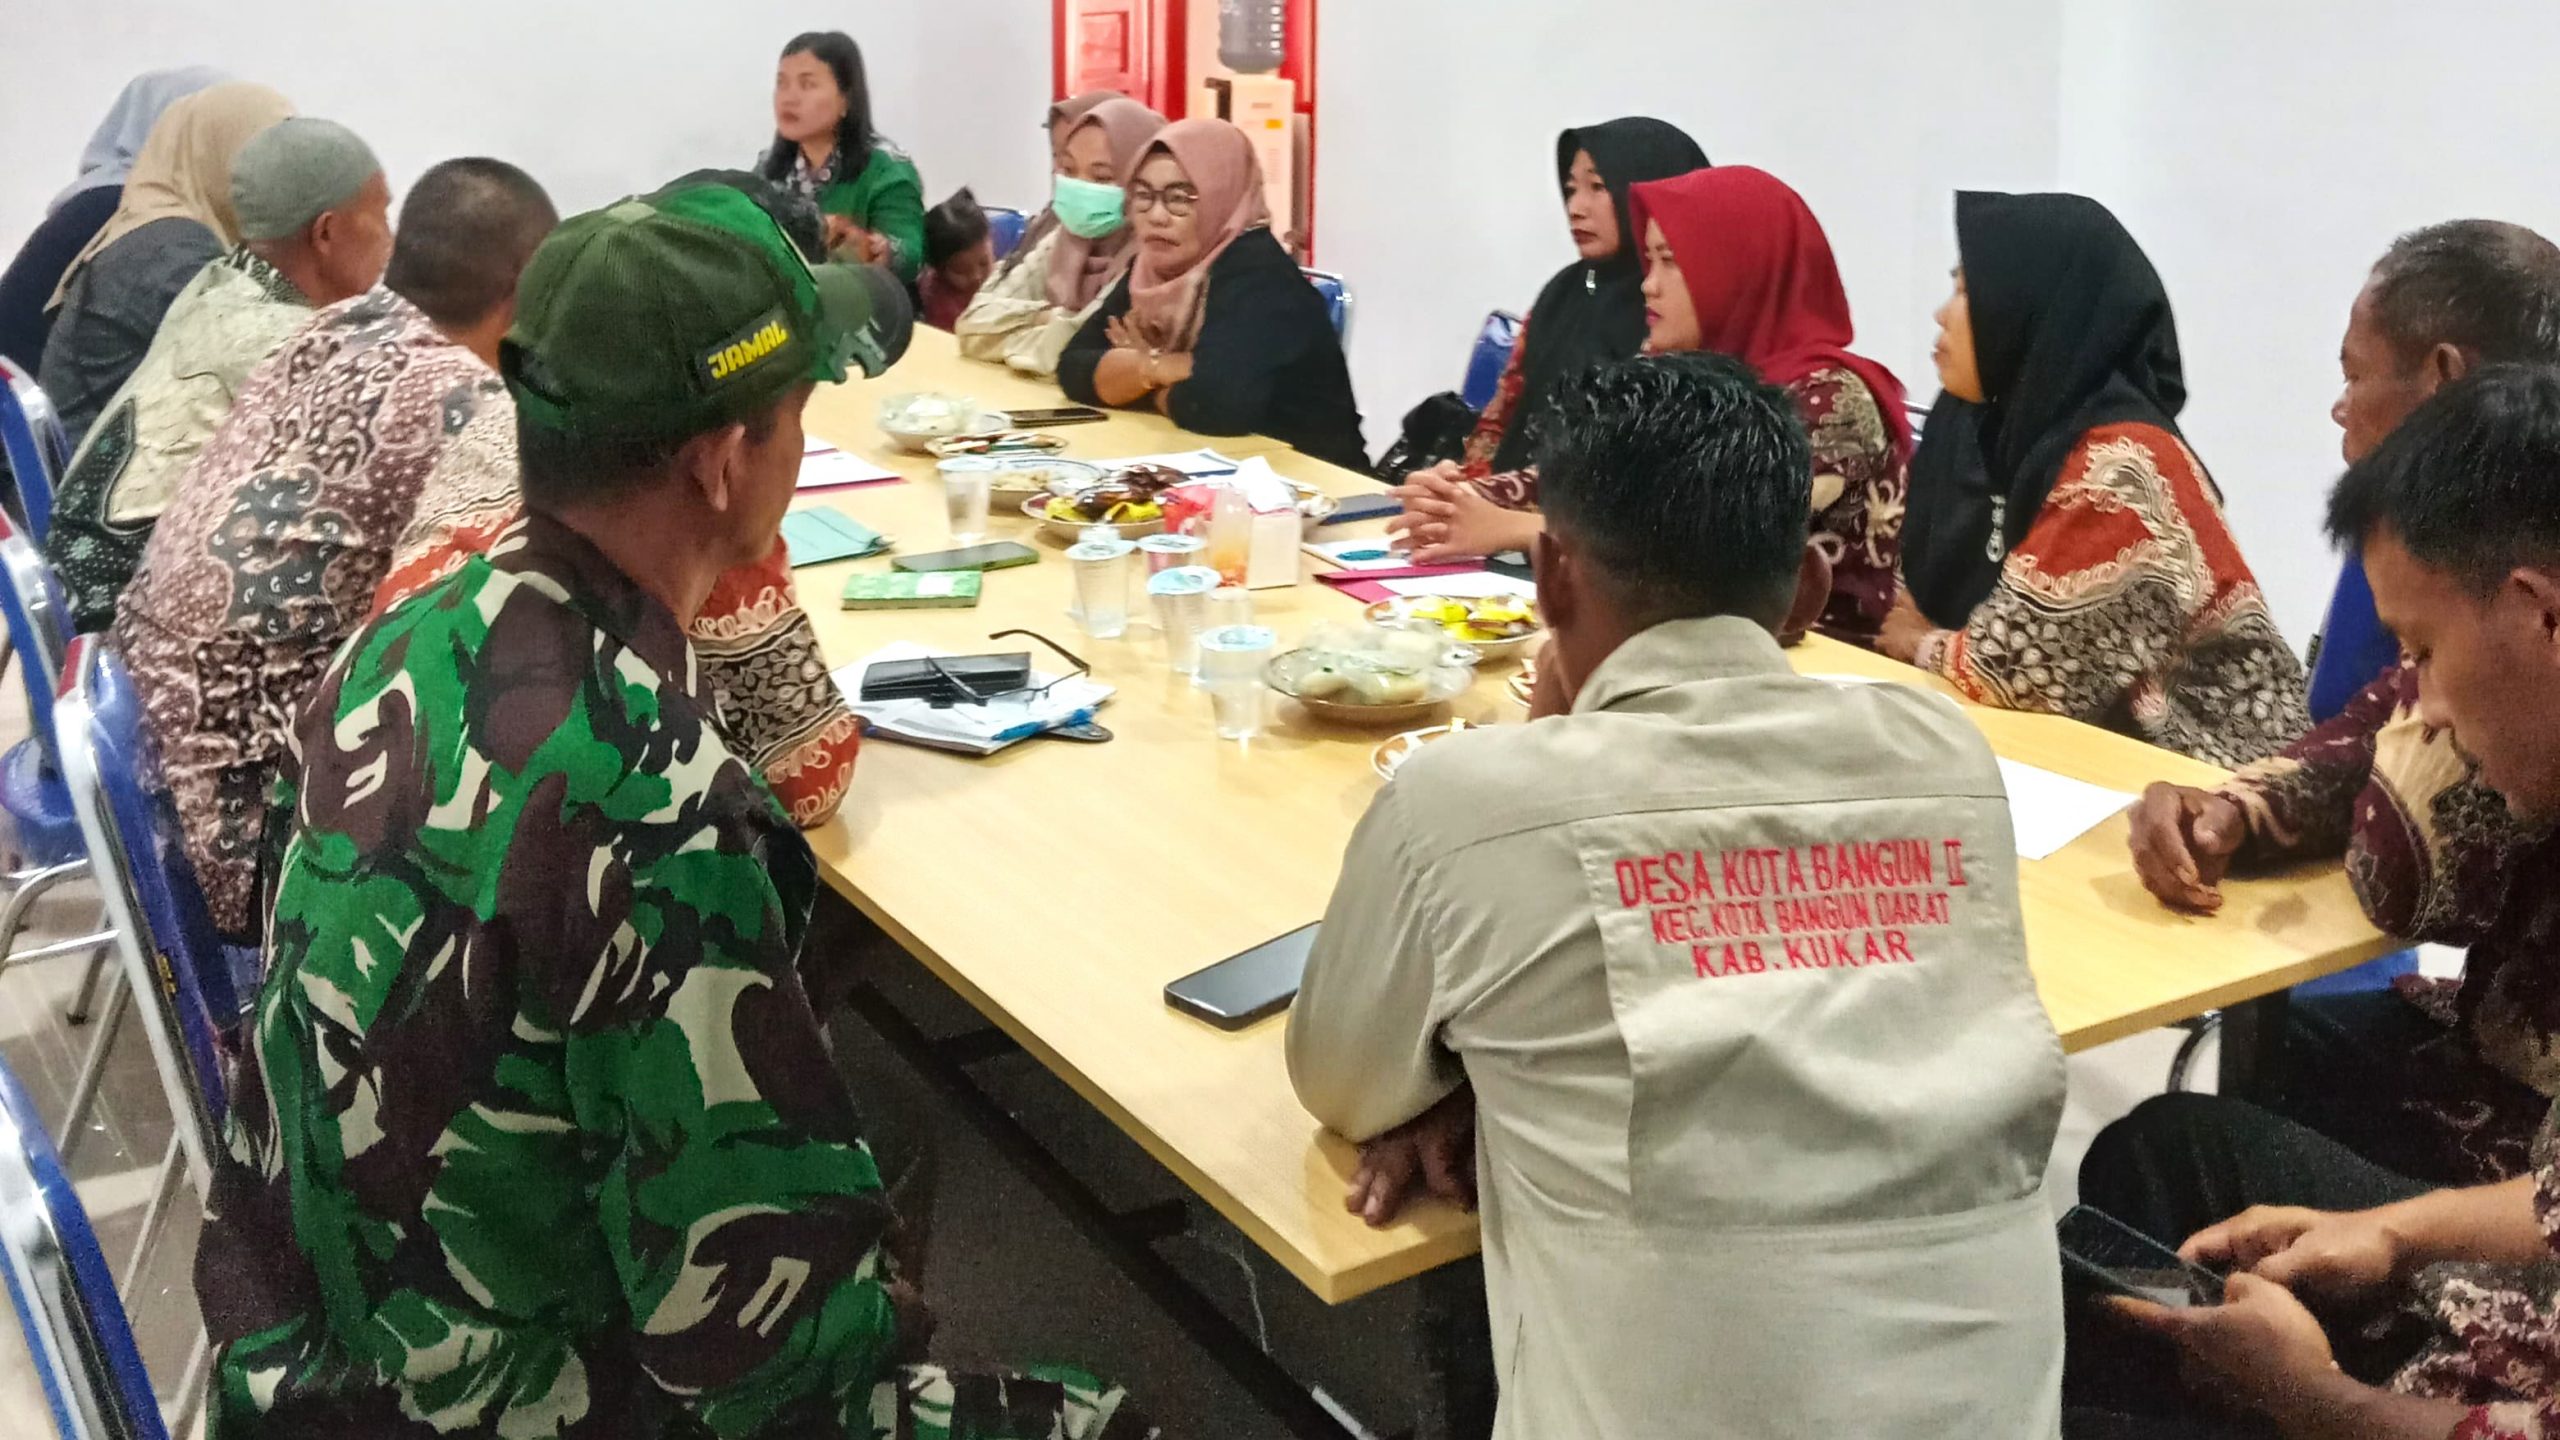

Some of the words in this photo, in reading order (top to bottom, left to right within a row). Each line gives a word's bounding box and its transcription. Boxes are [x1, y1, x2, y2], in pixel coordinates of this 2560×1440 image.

[707, 320, 788, 379] JAMAL
[1615, 850, 1716, 909] DESA
[1720, 846, 1808, 897] KOTA
[1810, 838, 1933, 892] BANGUN
[1774, 892, 1872, 935] BANGUN
[1874, 892, 1951, 926] DARAT
